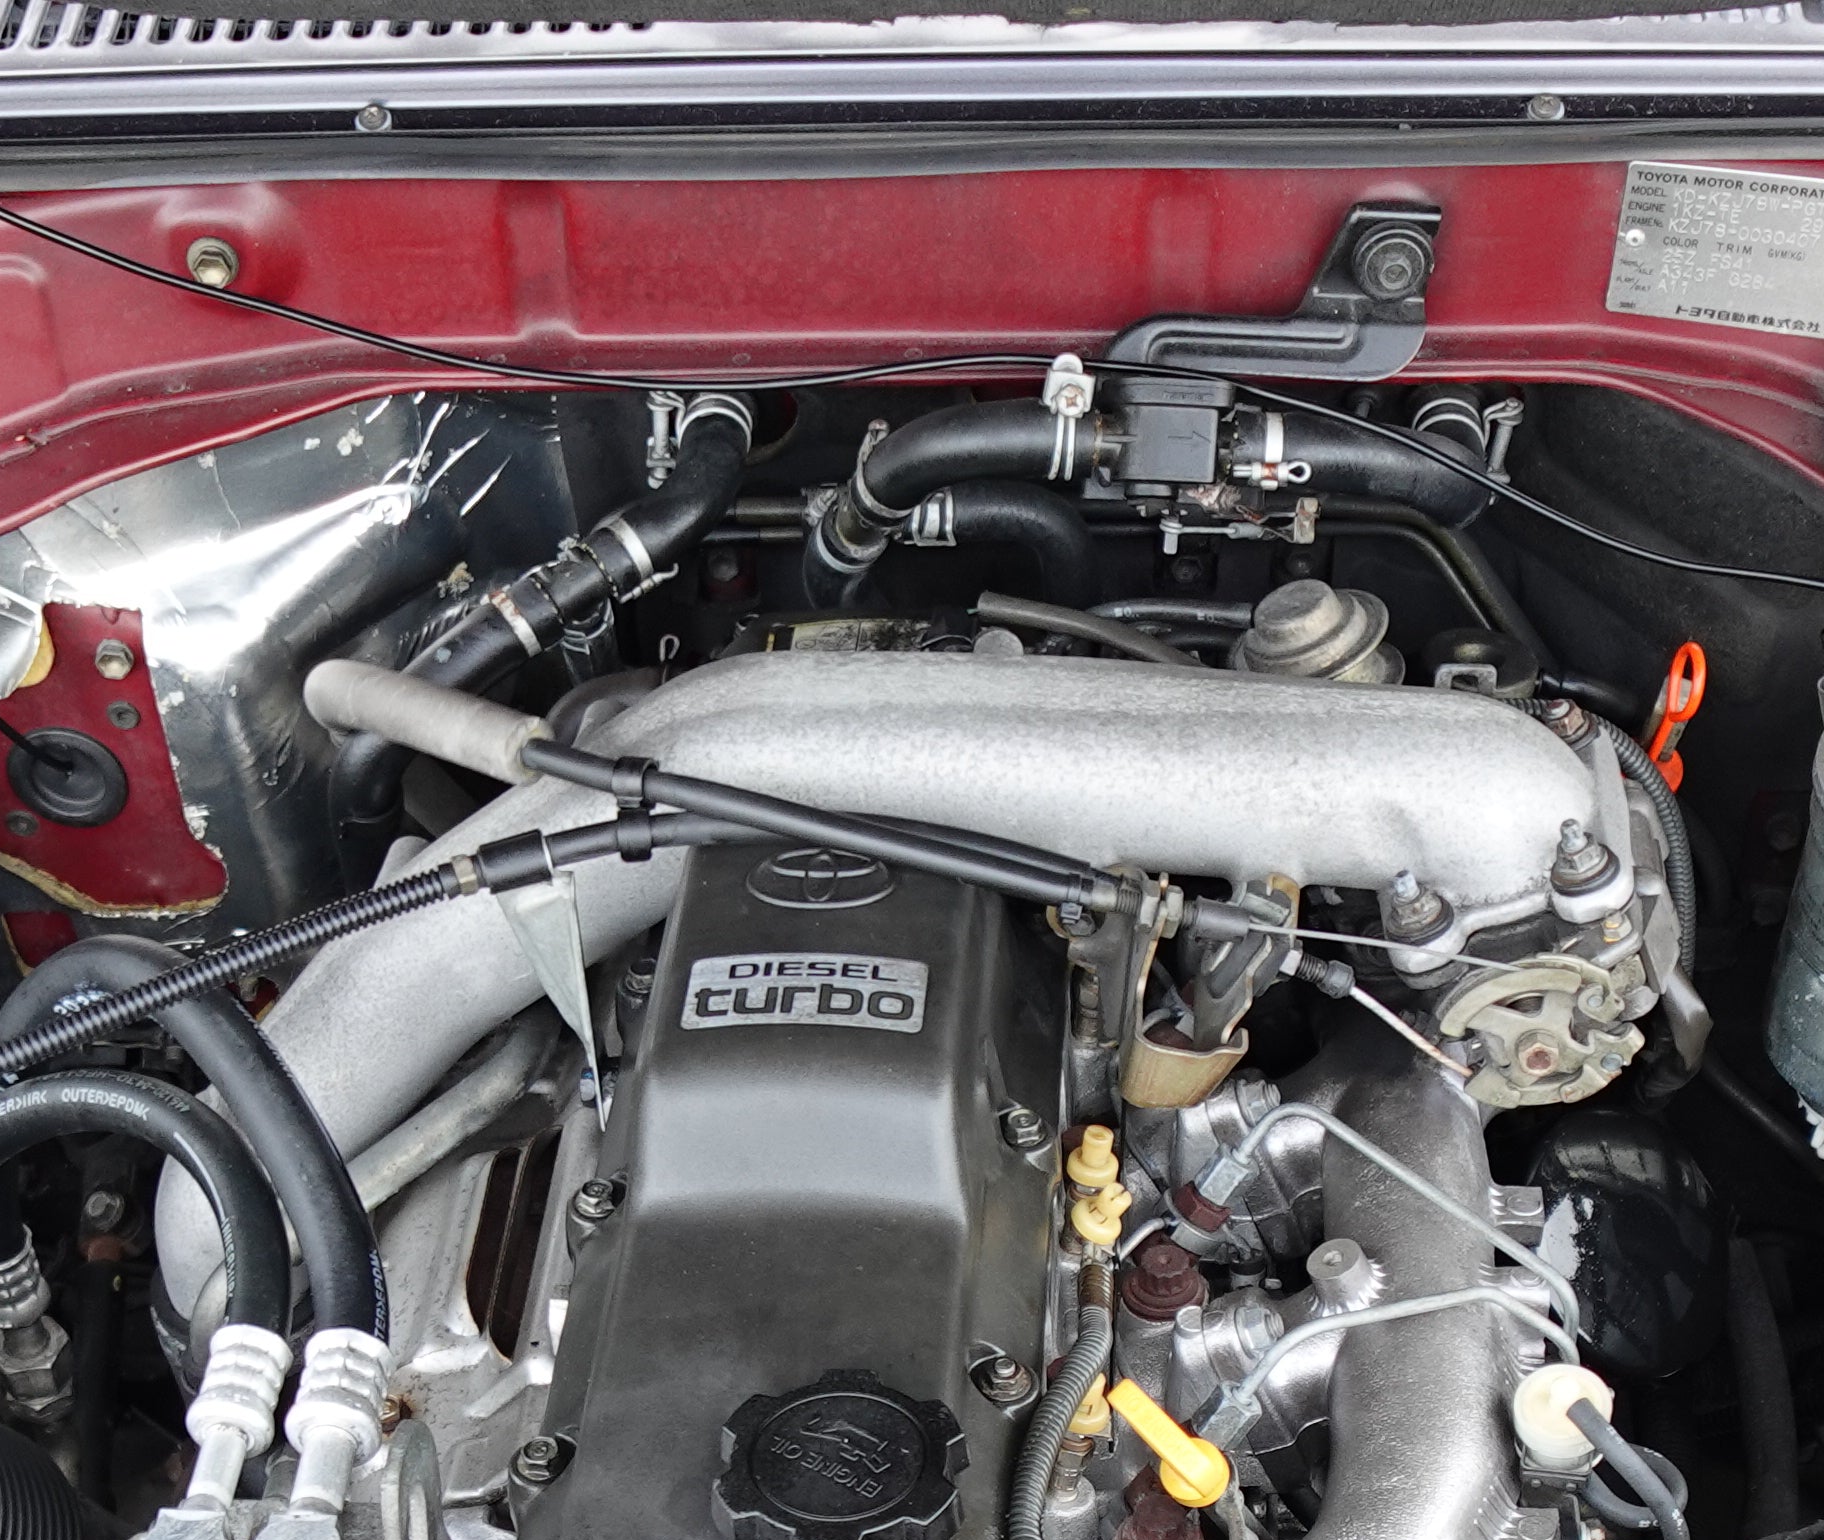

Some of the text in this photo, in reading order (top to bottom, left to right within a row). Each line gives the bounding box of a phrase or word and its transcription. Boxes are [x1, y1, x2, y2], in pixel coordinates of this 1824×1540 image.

[1637, 170, 1689, 186] TOYOTA
[1693, 175, 1743, 191] MOTOR
[1630, 185, 1667, 198] MODEL
[1627, 201, 1666, 213] ENGINE
[1663, 235, 1699, 249] COLOR
[1716, 241, 1753, 256] TRIM
[728, 961, 898, 982] DIESEL
[694, 983, 914, 1020] turbo
[772, 1436, 884, 1499] ENGINE OIL
